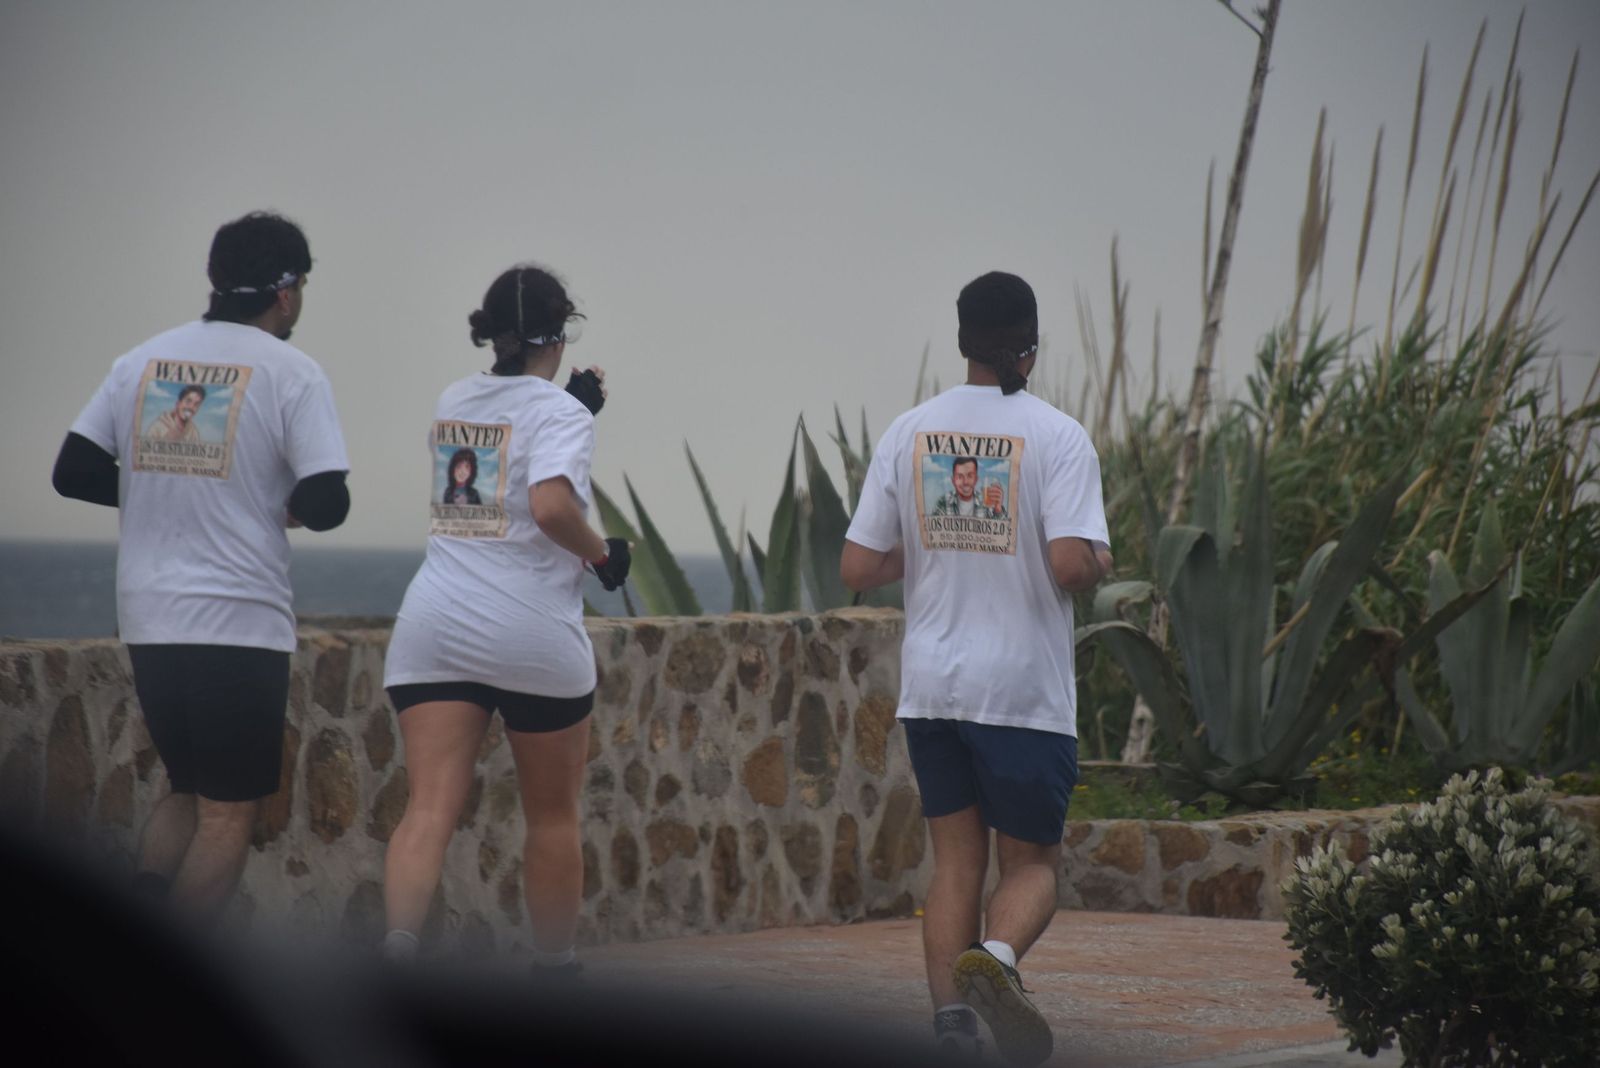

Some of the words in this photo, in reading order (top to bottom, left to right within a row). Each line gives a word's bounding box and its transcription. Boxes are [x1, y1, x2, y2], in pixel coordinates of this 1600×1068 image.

[156, 362, 240, 385] WANTED
[437, 423, 504, 447] WANTED
[926, 434, 1013, 458] WANTED
[928, 517, 942, 532] LOS
[993, 522, 1005, 535] 2.0
